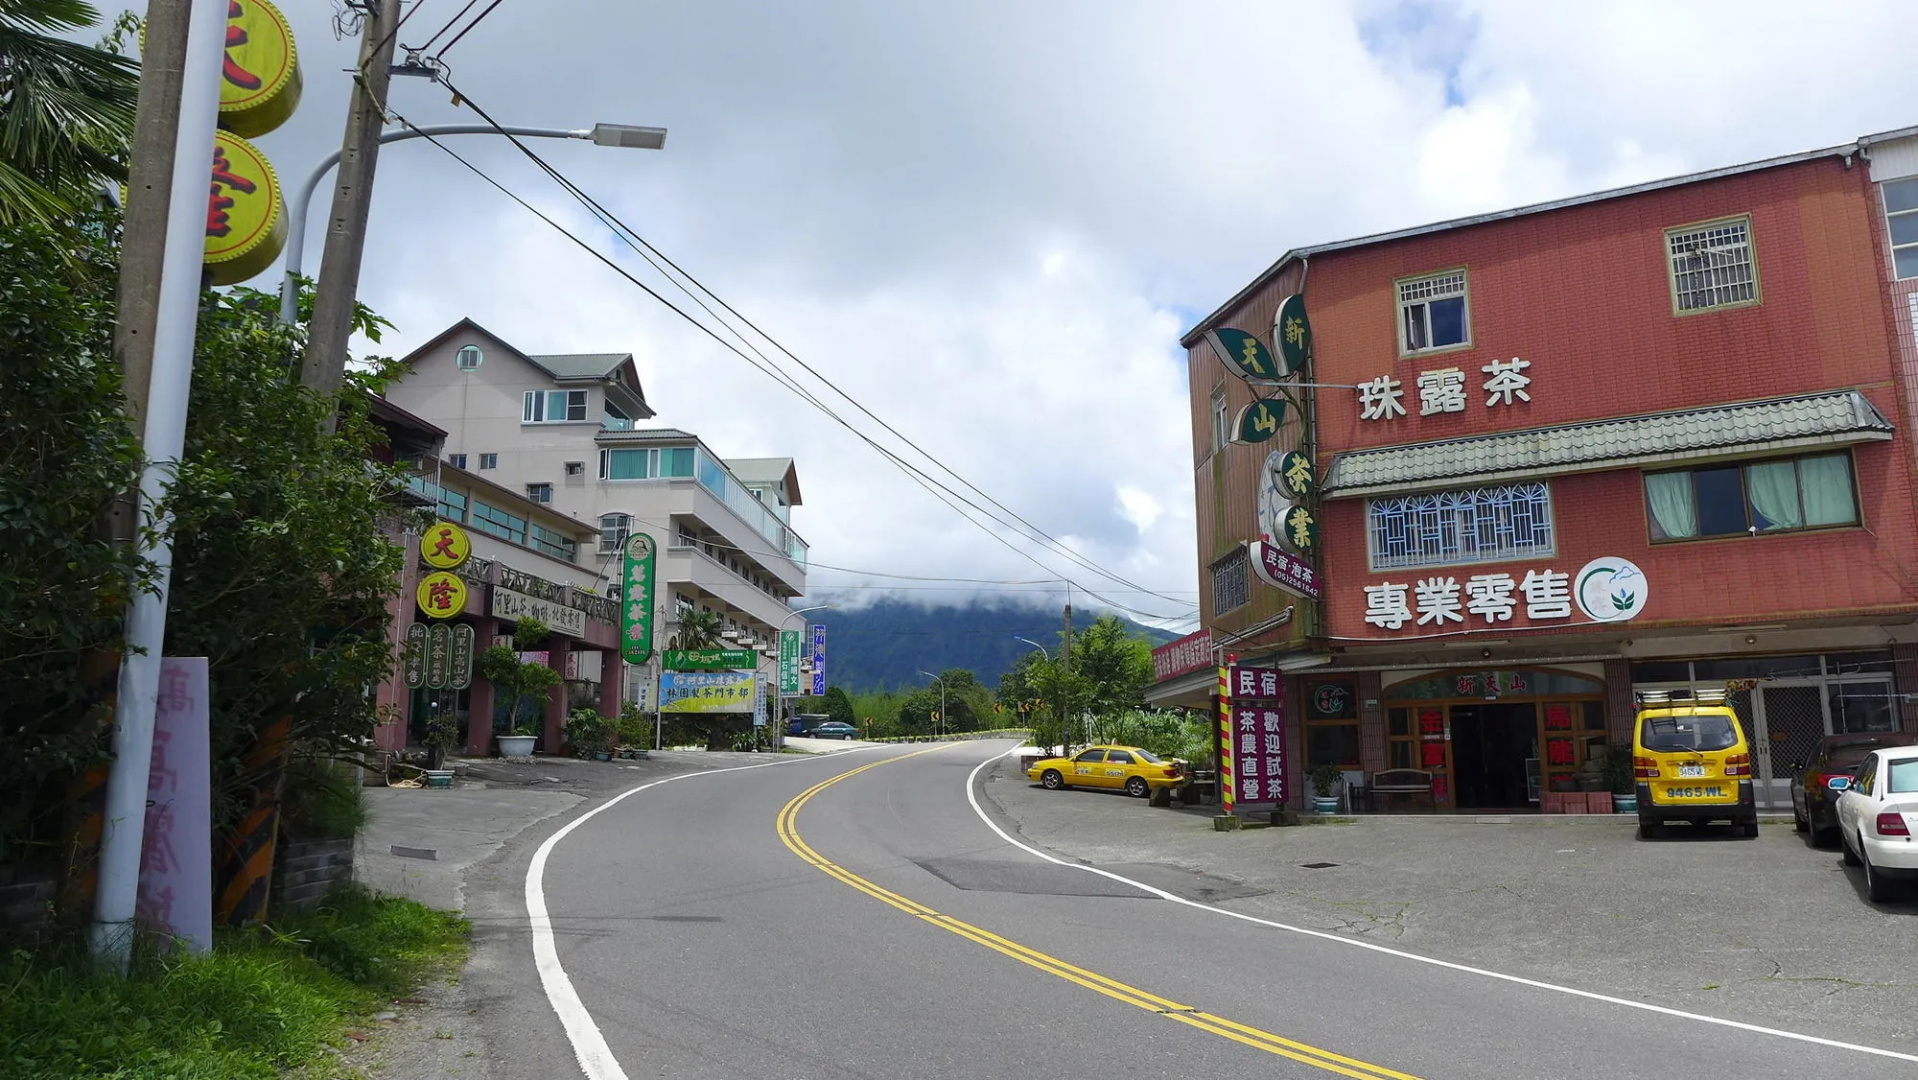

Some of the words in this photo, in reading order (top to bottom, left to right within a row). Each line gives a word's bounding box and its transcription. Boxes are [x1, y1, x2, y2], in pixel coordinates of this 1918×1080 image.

[1357, 357, 1532, 420] 珠露茶
[1285, 453, 1314, 548] 茶業
[429, 528, 459, 609] 天隆
[1363, 569, 1573, 630] 專業零售
[1239, 670, 1277, 696] 民宿
[1457, 674, 1527, 694] 新天山
[1239, 710, 1259, 800] 茶農直營
[1263, 711, 1282, 799] 歡迎試茶
